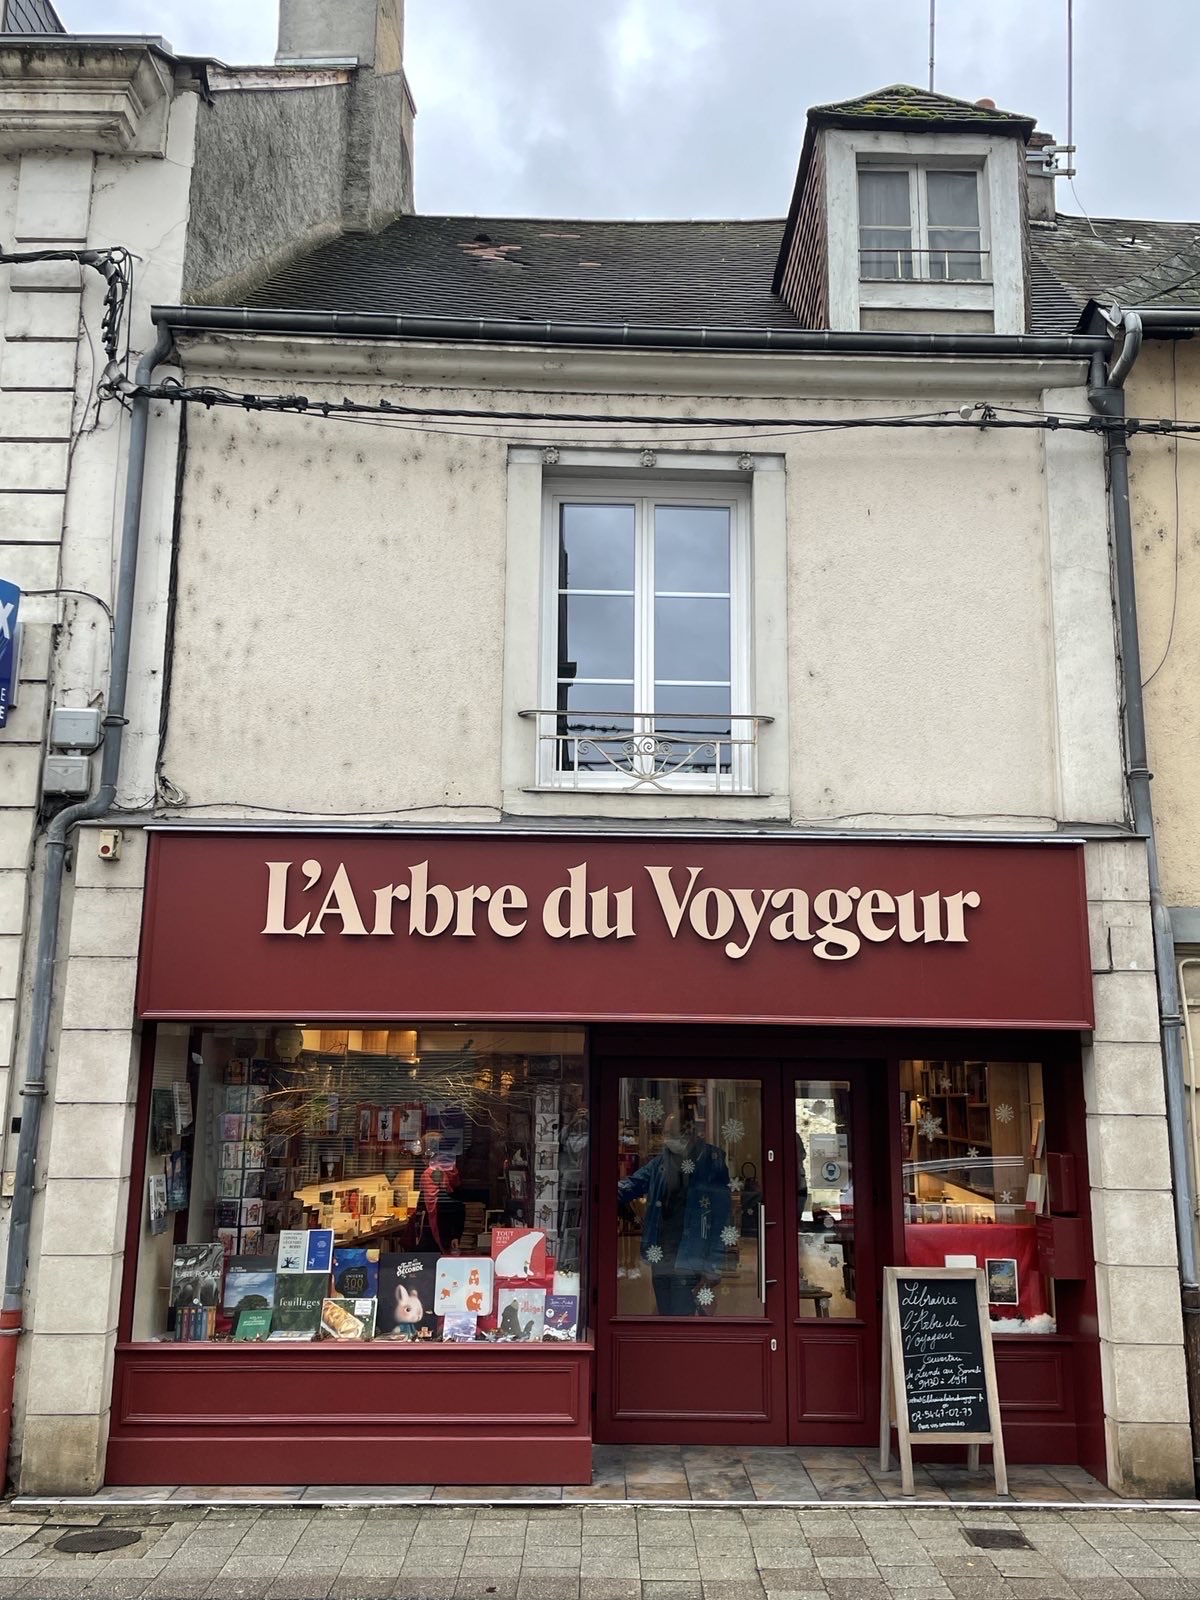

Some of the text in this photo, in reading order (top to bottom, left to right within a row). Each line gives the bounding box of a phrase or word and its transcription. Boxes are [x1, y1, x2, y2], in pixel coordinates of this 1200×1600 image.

[261, 860, 980, 960] L'Arbre du Voyageur
[195, 1270, 221, 1278] ROMAN
[902, 1282, 958, 1307] Librairie
[279, 1297, 320, 1309] feuillages
[945, 1314, 967, 1328] du
[905, 1332, 955, 1352] Voyageur
[915, 1364, 940, 1380] Lundi
[918, 1376, 939, 1390] 9H30
[947, 1375, 967, 1385] 19H
